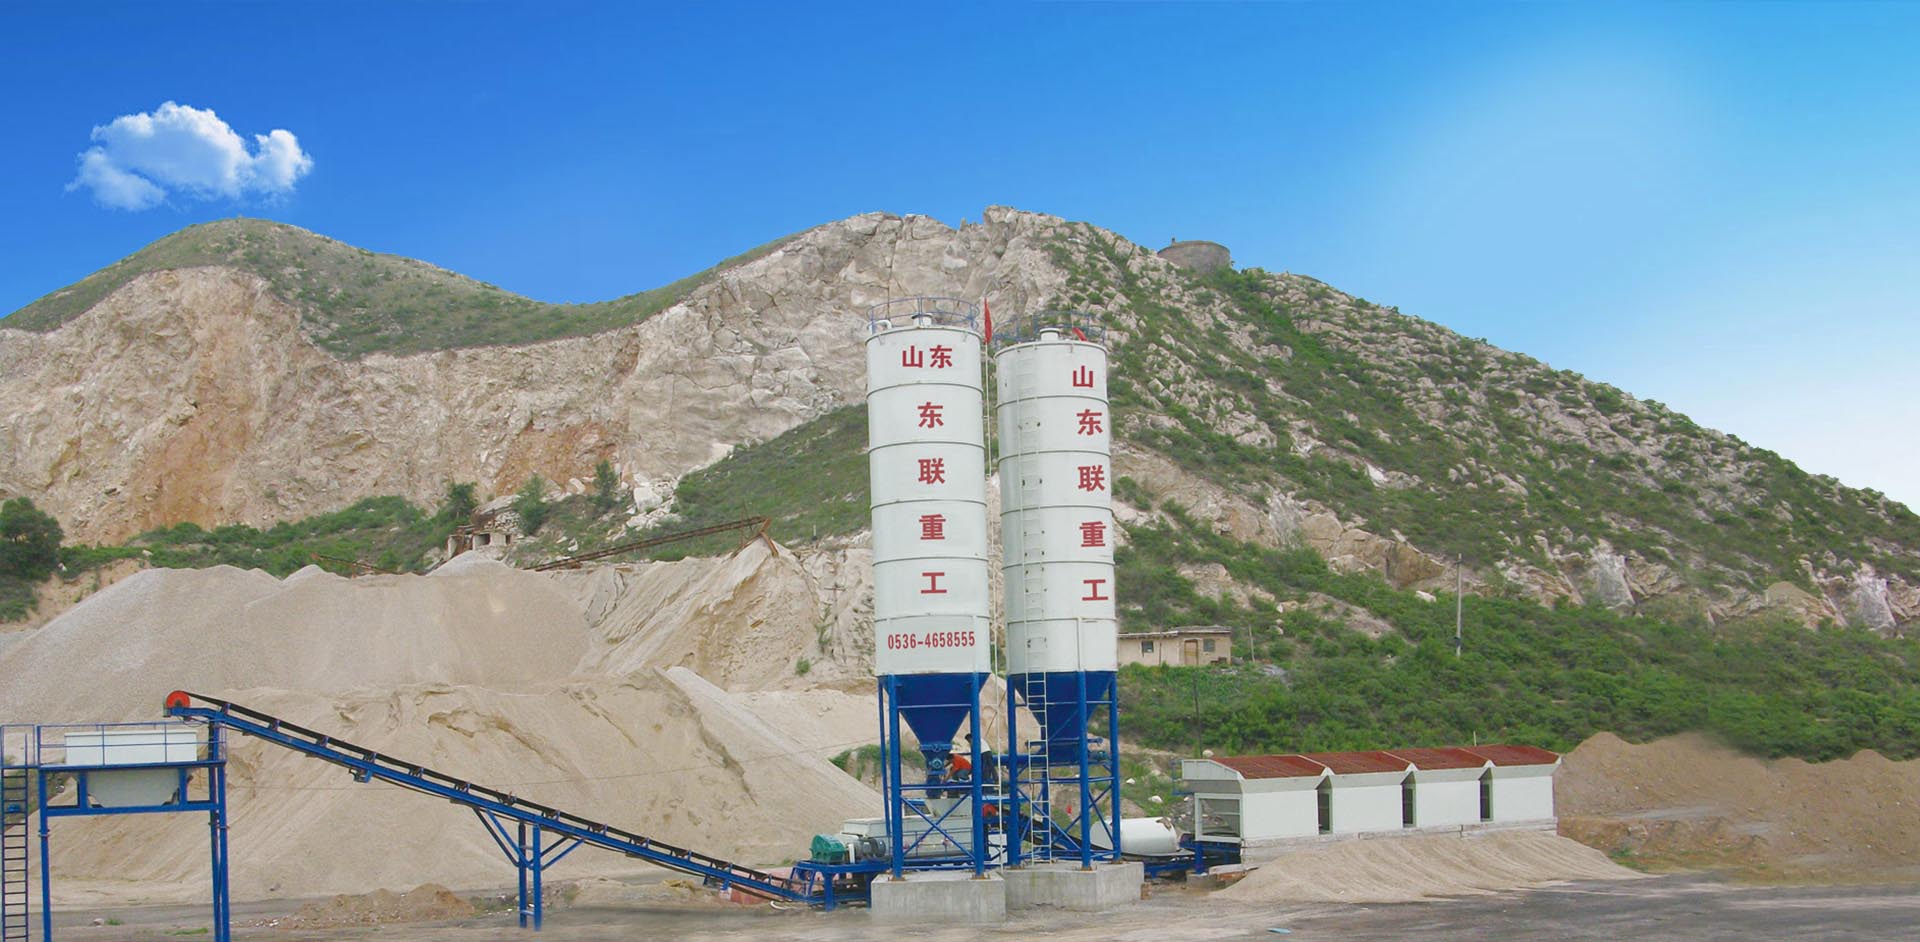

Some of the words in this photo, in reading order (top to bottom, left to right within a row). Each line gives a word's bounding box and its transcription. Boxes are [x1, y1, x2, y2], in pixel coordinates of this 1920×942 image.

[901, 344, 953, 369] 山东
[917, 401, 948, 595] 东联重工
[887, 631, 976, 650] 0536-4658555
